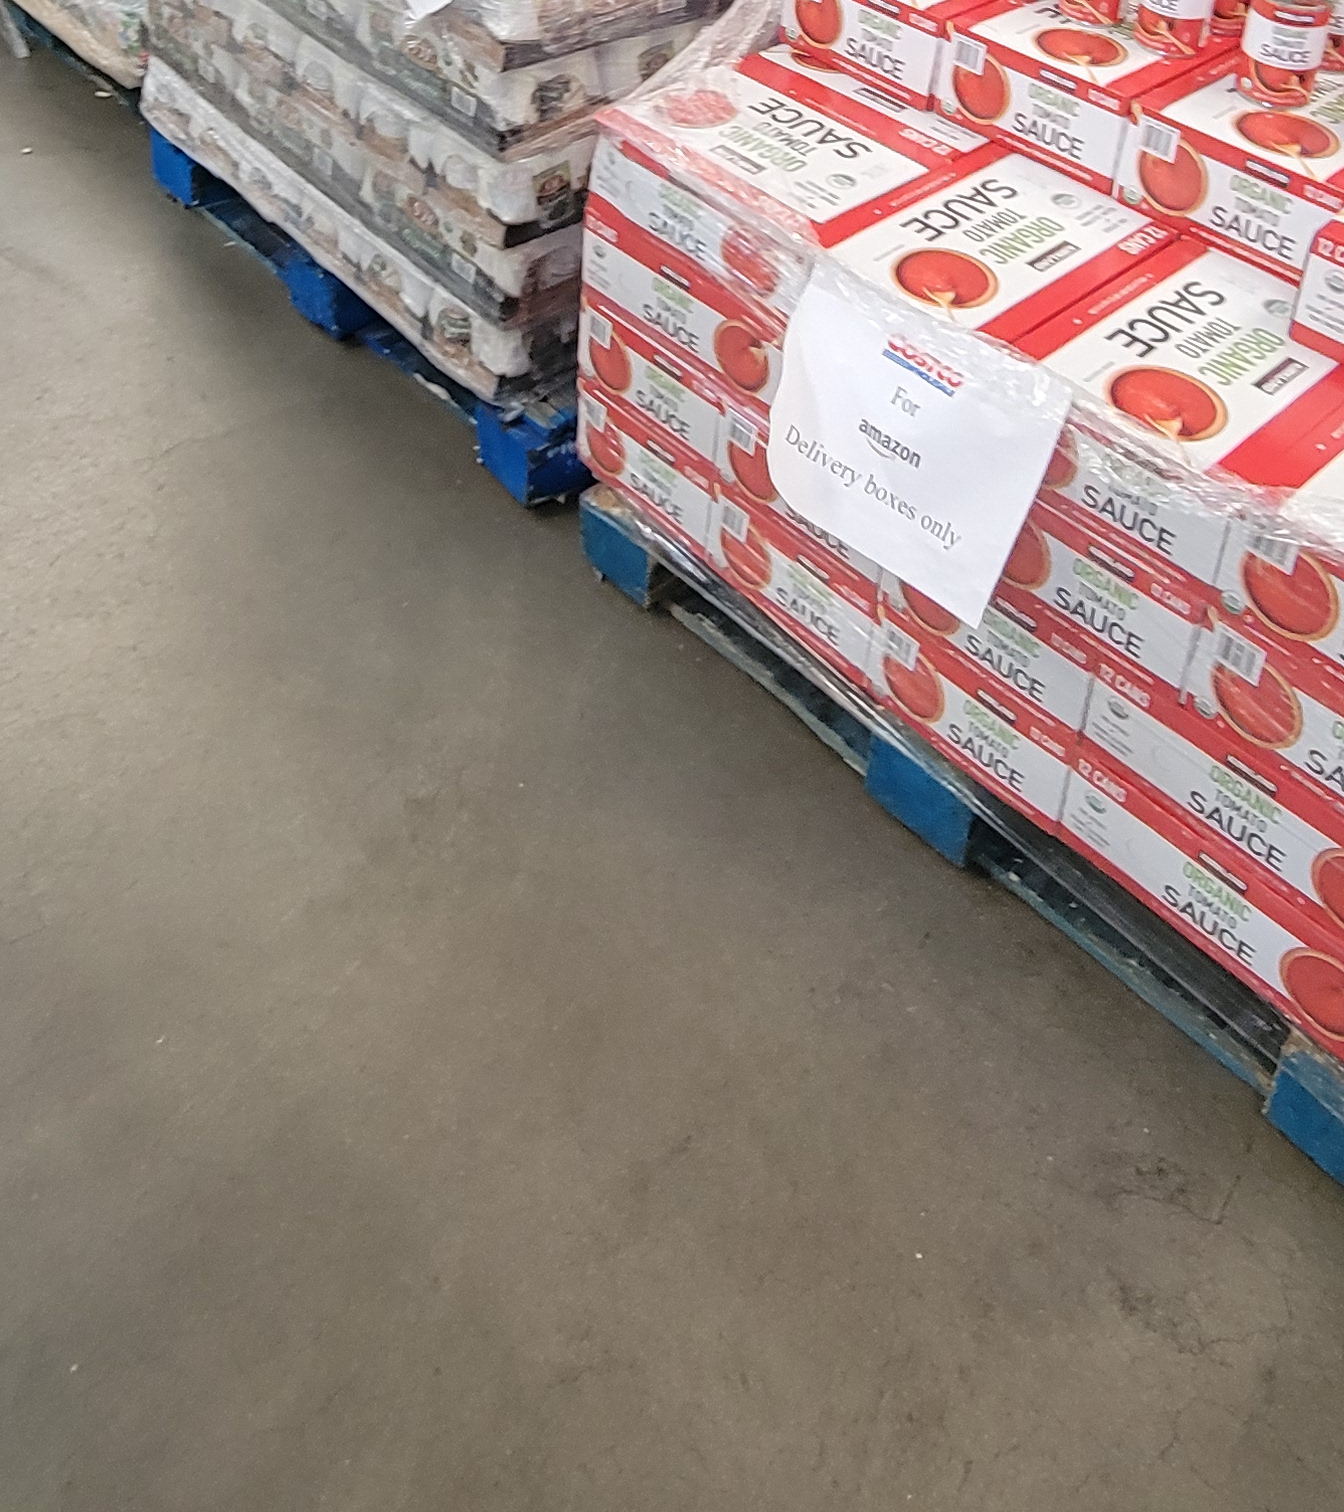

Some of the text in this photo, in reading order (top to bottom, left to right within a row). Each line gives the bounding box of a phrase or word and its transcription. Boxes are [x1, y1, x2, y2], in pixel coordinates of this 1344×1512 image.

[846, 37, 906, 81] SAUCE
[747, 96, 874, 160] SAUCE
[1012, 111, 1086, 161] SAUCE
[899, 178, 1019, 242] SAUCE
[964, 208, 1027, 243] TOMATO
[980, 216, 1066, 264] ORGANIC
[1209, 205, 1297, 261] SAUCE
[642, 303, 700, 355] SAUCE
[1104, 280, 1228, 358] SAUCE
[1176, 317, 1243, 360] TOMATO
[1197, 327, 1287, 387] ORGANIC
[635, 390, 691, 441] SAUCE
[889, 385, 922, 419] For
[857, 417, 923, 470] amazon
[784, 424, 963, 552] Delivery boxes only
[1080, 483, 1178, 556] SAUCE
[1054, 586, 1147, 659] SAUCE
[964, 633, 1046, 704] SAUCE
[946, 722, 1027, 794] SAUCE
[1209, 765, 1284, 825] ORGANIC
[1186, 789, 1289, 873] SAUCE
[1182, 860, 1254, 924] ORGANIC
[1188, 884, 1239, 931] TOMATO
[1161, 884, 1258, 968] SAUCE
